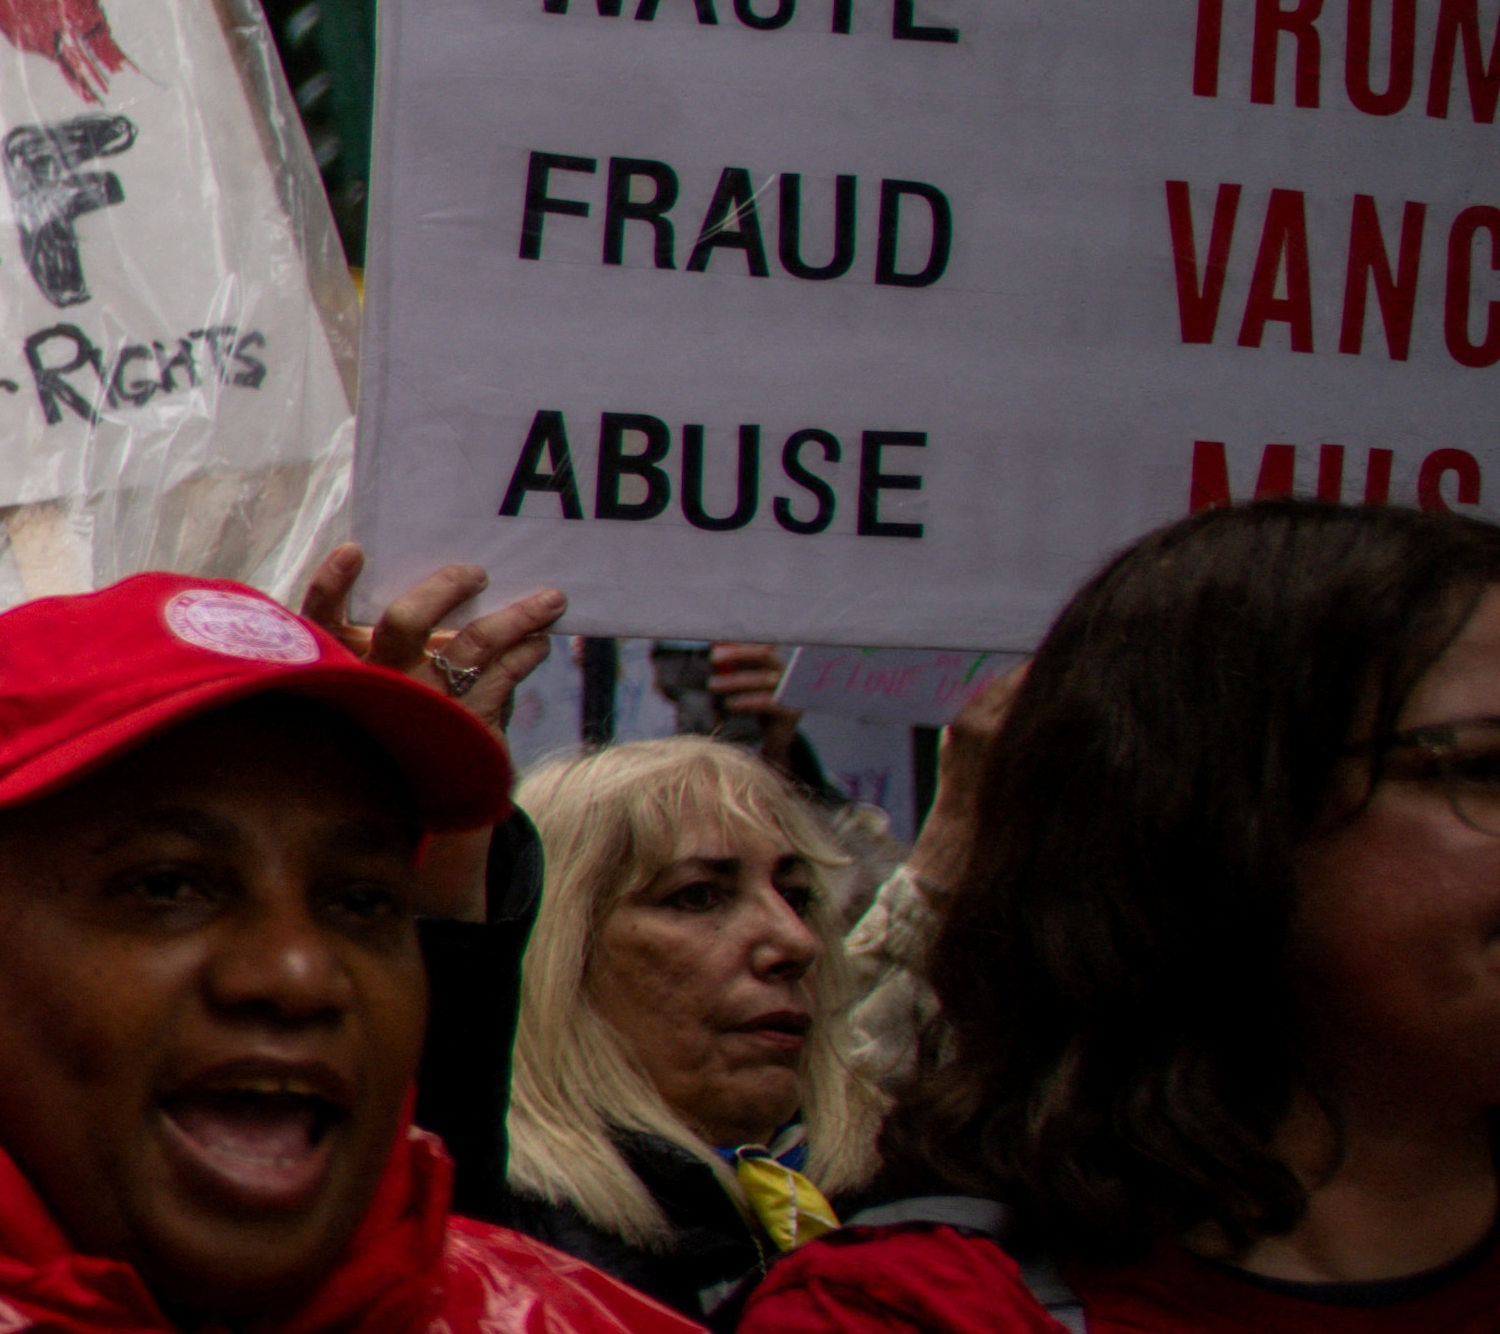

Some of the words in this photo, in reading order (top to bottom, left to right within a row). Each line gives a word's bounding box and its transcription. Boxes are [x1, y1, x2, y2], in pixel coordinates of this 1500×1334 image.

[518, 151, 953, 287] FRAUD
[1165, 180, 1500, 368] VANC
[498, 408, 929, 539] ABUSE
